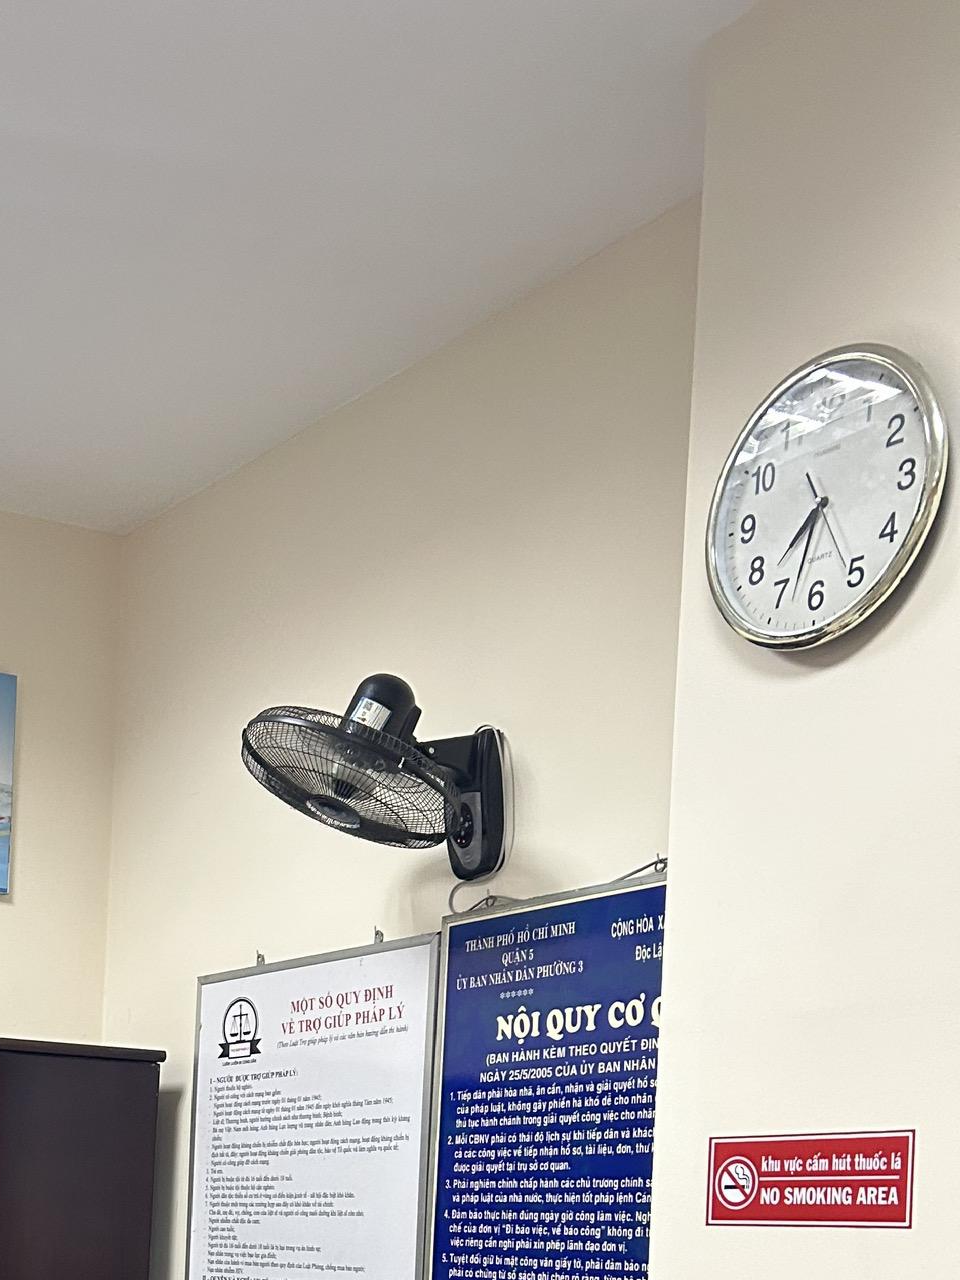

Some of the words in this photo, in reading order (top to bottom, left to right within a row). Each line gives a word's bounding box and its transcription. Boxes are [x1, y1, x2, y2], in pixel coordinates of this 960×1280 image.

[886, 414, 906, 448] 2
[752, 462, 776, 495] 10
[897, 458, 916, 491] 3
[741, 514, 756, 544] 9
[879, 512, 898, 543] 4
[748, 556, 764, 585] 8
[847, 555, 865, 587] 5
[774, 578, 790, 609] 7
[808, 580, 825, 611] 6
[465, 936, 495, 952] THÀNH
[497, 928, 515, 947] PHỐ
[517, 924, 530, 943] HỒ
[532, 923, 548, 940] CHÍ
[550, 922, 575, 937] MINH
[611, 918, 634, 940] CỘNG
[636, 914, 654, 934] HÒA
[502, 948, 527, 966] QUẬN
[529, 949, 534, 960] 5
[636, 945, 651, 962] Độc
[653, 943, 662, 960] Lậ
[470, 974, 487, 988] BAN
[489, 969, 513, 986] NHÂN
[516, 966, 535, 981] DÂN
[537, 960, 576, 978] PHƯỜNG
[578, 960, 583, 972] 3
[336, 990, 361, 1009] QUY
[364, 985, 393, 1004] ĐỊNH
[298, 1017, 322, 1034] TRỢ
[496, 1006, 540, 1044] NỘI
[546, 1004, 602, 1040] QUY
[608, 993, 645, 1028] CƠ
[486, 1052, 508, 1067] (BAN
[512, 1048, 540, 1062] HÀNH
[543, 1046, 565, 1059] KÈM
[569, 1043, 596, 1057] THEO
[600, 1036, 637, 1054] QUYẾT
[641, 1038, 659, 1051] ĐỊN
[480, 1069, 506, 1082] NGÀY
[509, 1067, 552, 1081] 25/5/2005
[555, 1062, 577, 1077] CỦA
[580, 1060, 595, 1075] ỦY
[598, 1060, 621, 1074] BAN
[624, 1056, 655, 1072] NHÂN
[762, 1156, 780, 1172] khu
[784, 1156, 802, 1175] vực
[806, 1152, 828, 1171] cấm
[832, 1153, 851, 1171] hút
[855, 1151, 887, 1171] thuốc
[892, 1151, 901, 1170] lá
[760, 1187, 780, 1205] NO
[784, 1187, 852, 1205] SMOKING
[856, 1187, 898, 1205] AREA
